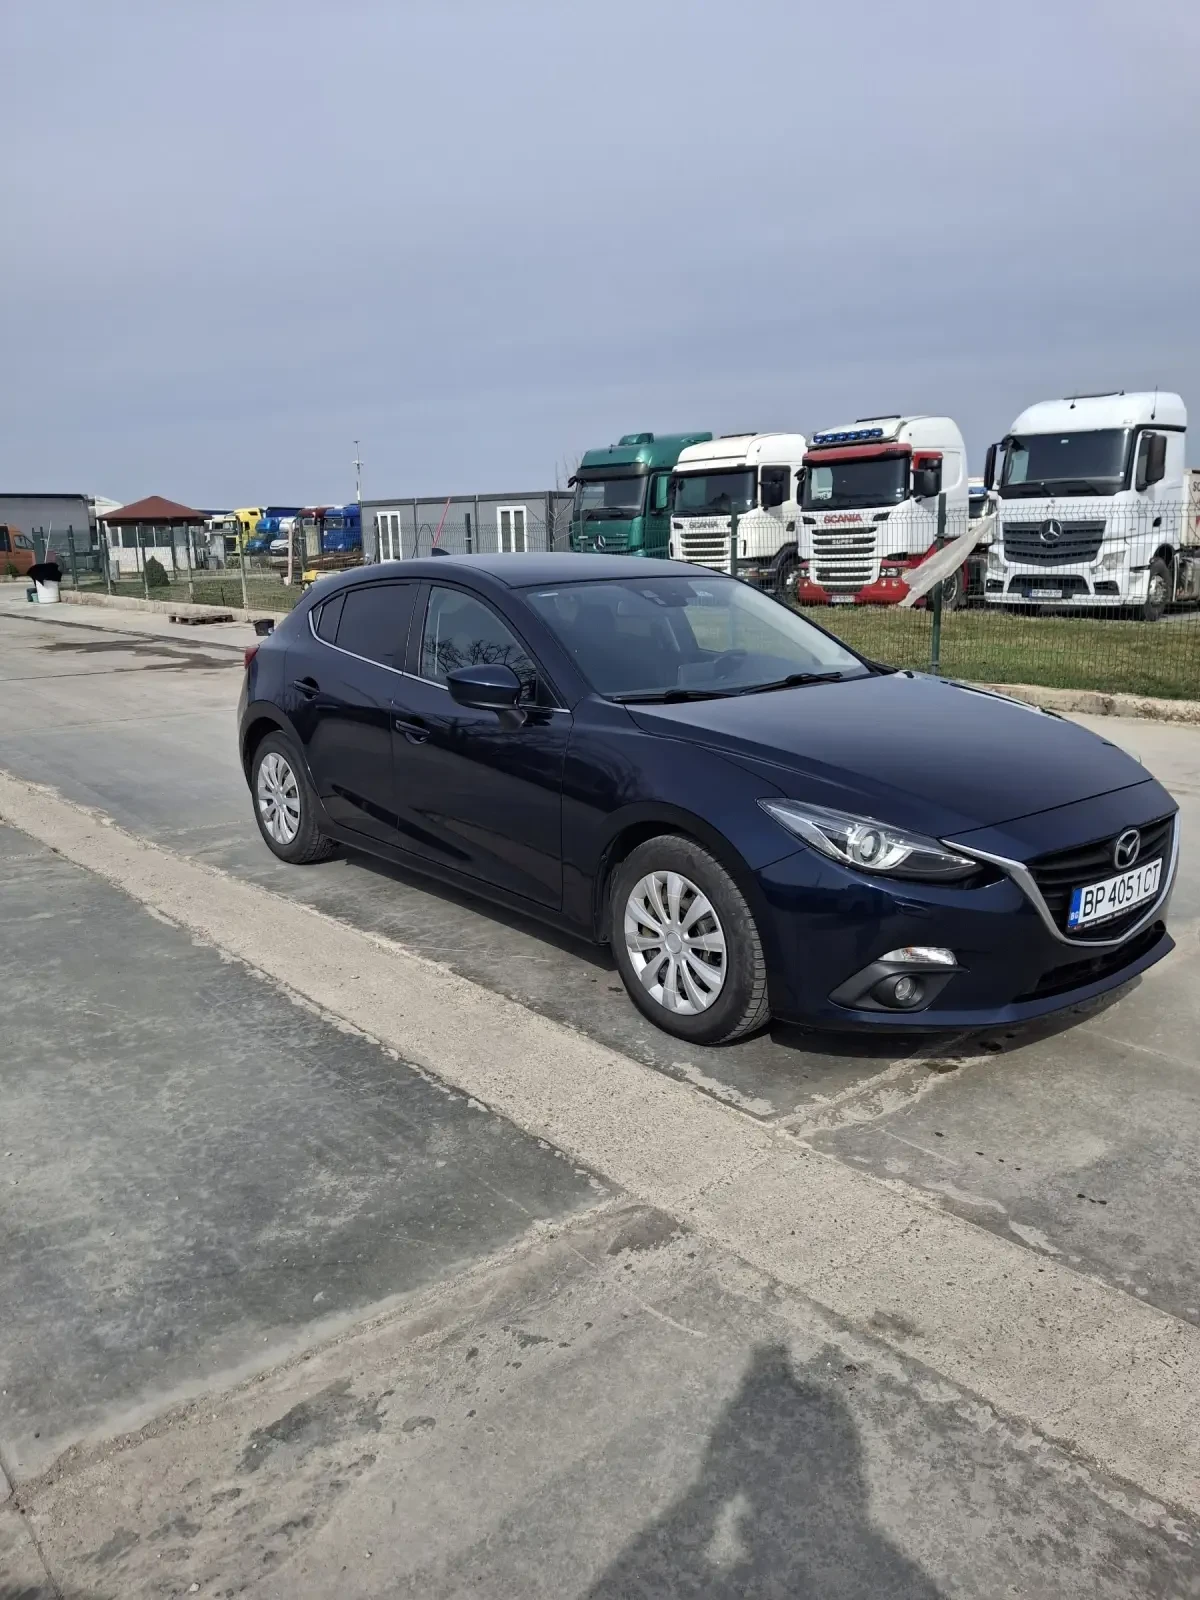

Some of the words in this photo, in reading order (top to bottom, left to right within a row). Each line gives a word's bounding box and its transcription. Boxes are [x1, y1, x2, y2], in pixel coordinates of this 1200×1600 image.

[824, 514, 863, 524] SCANIA
[689, 521, 719, 529] SCANIA
[1083, 887, 1105, 917] BP
[1108, 872, 1142, 908] 4051
[1143, 863, 1159, 893] CT
[1070, 911, 1080, 920] BG
